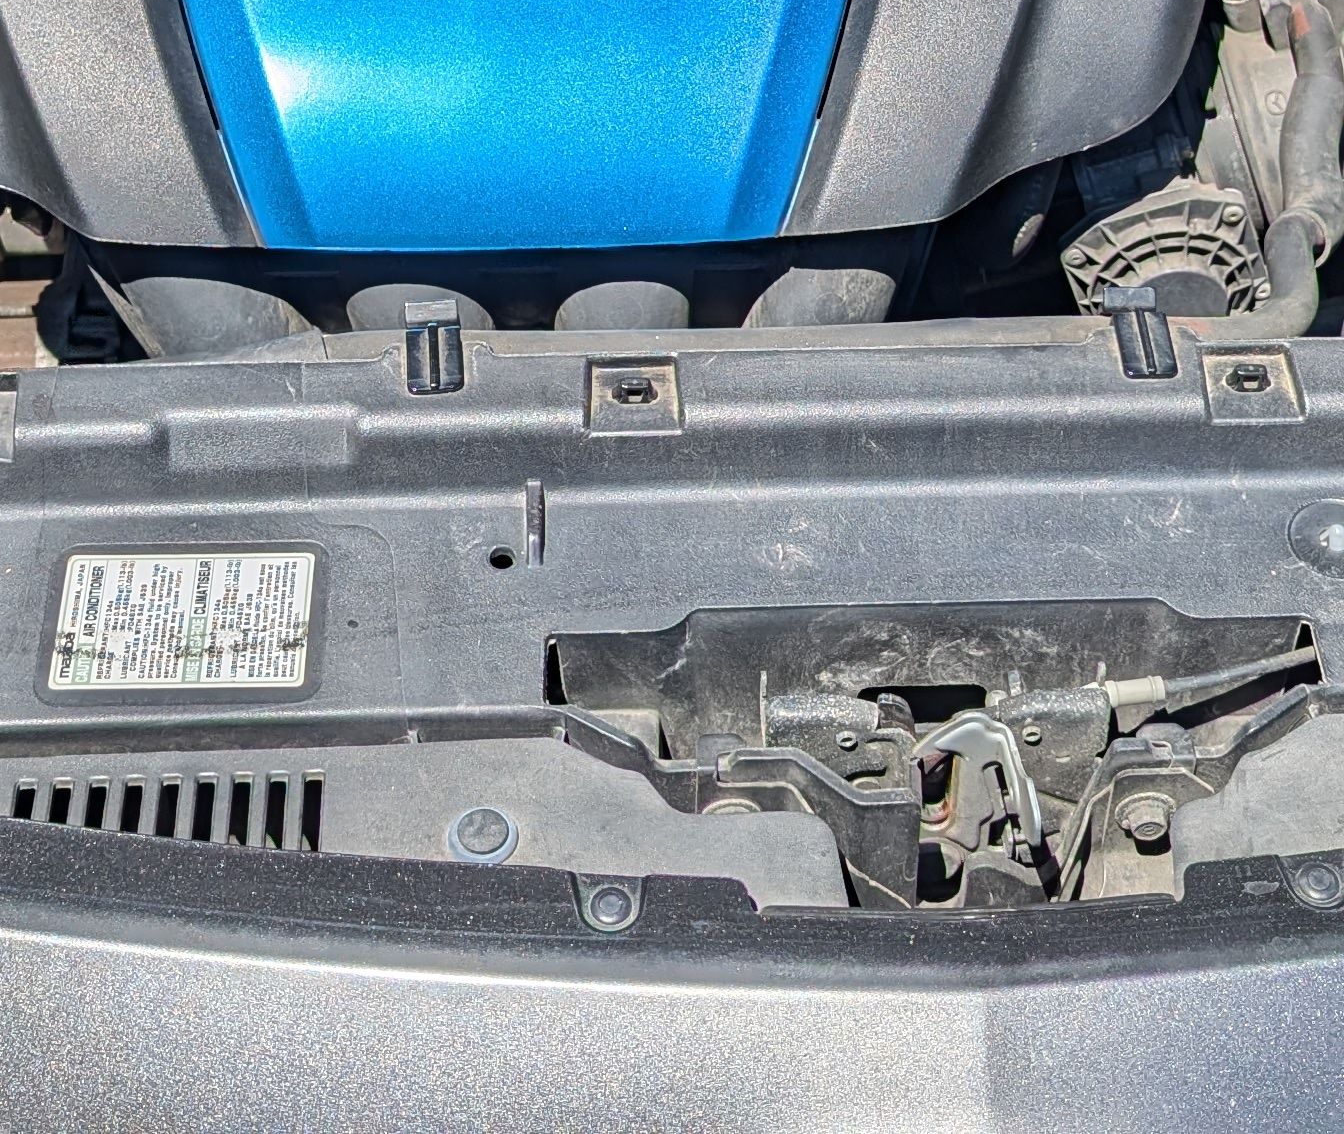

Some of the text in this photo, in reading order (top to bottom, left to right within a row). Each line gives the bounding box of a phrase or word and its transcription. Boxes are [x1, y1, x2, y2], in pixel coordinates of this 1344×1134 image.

[76, 563, 86, 586] JAPAN
[193, 560, 211, 614] CLIMATISEUR
[82, 565, 104, 637] AIR CONDITIONER
[74, 645, 92, 682] CAUTIN
[184, 661, 199, 681] MISE
